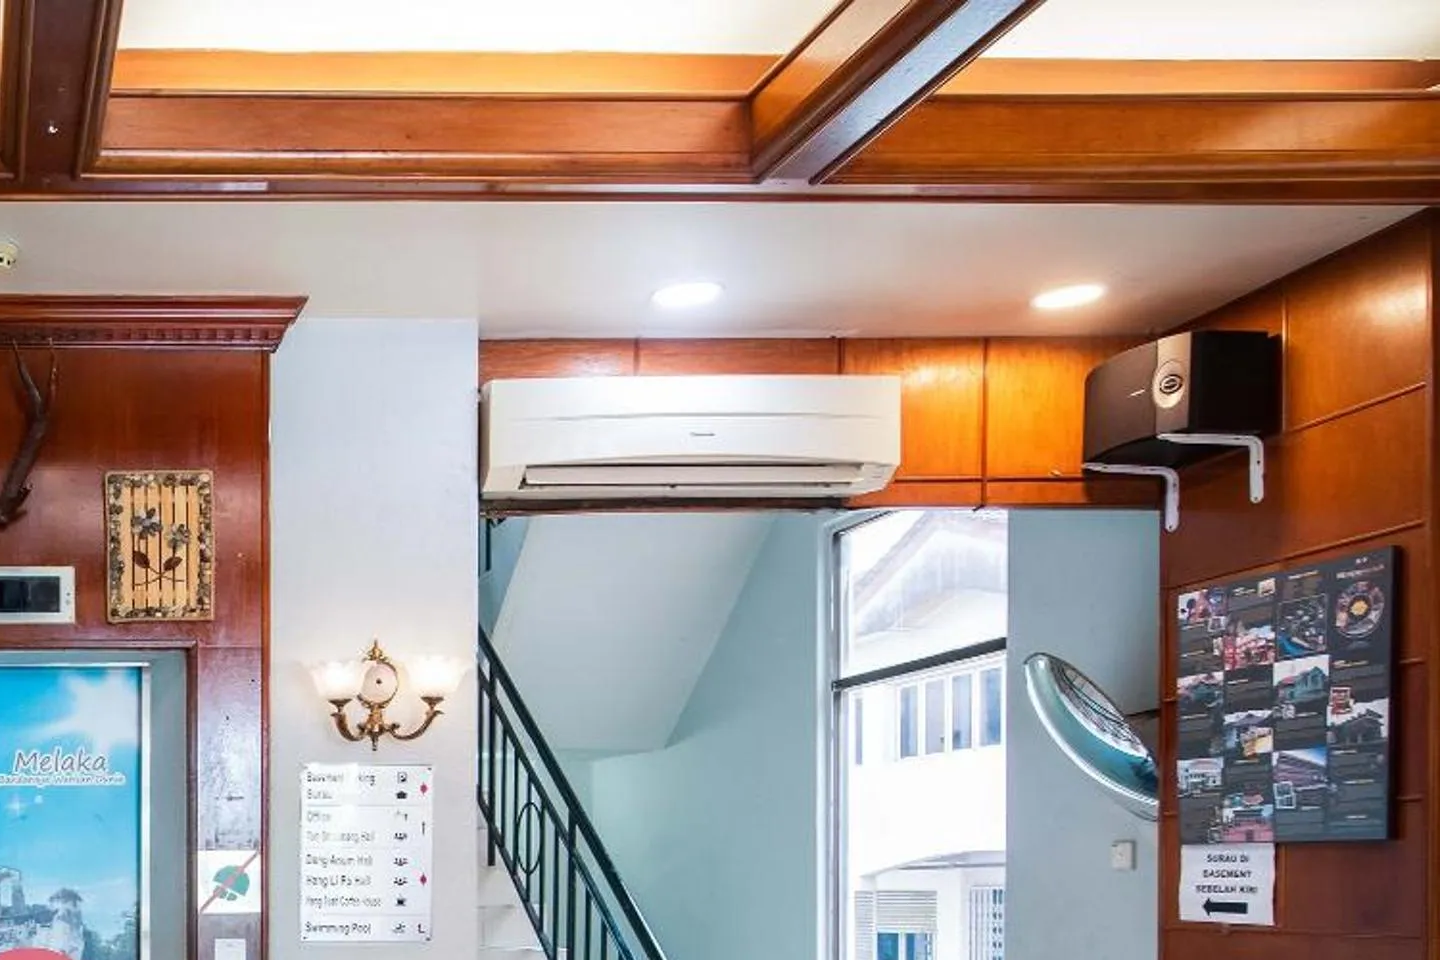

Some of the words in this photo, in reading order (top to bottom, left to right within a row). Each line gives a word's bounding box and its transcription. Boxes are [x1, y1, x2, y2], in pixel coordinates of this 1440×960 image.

[14, 747, 108, 774] Melaka
[1206, 854, 1238, 863] SURAU
[1240, 854, 1250, 862] DI
[1195, 885, 1237, 894] SEBELAH
[305, 921, 350, 936] Swimming
[351, 922, 372, 935] Pool
